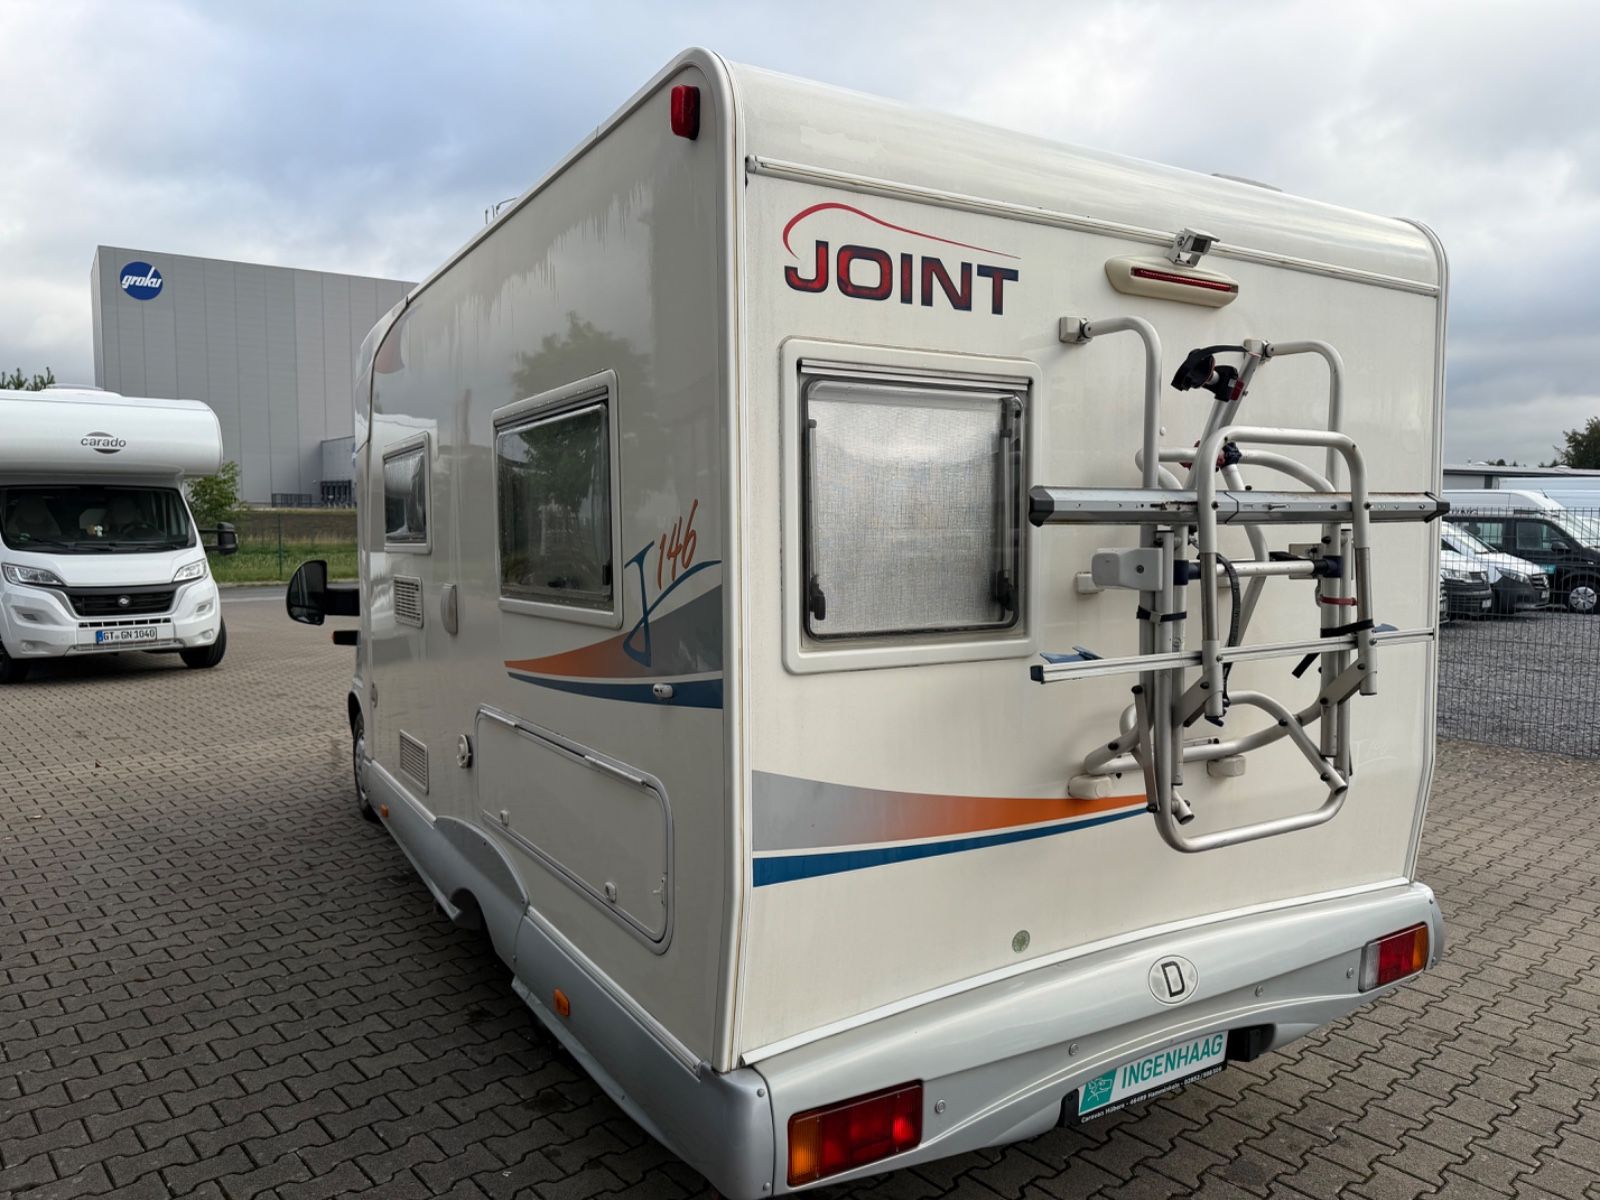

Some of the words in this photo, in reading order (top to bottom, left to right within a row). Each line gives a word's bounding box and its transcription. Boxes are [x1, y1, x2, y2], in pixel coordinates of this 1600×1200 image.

[784, 240, 1019, 315] JOINT
[81, 437, 127, 447] carado
[104, 631, 113, 640] GT
[121, 630, 132, 640] GN
[134, 629, 155, 639] 1040
[1161, 961, 1185, 997] D
[1121, 1034, 1223, 1089] INGENHAAG
